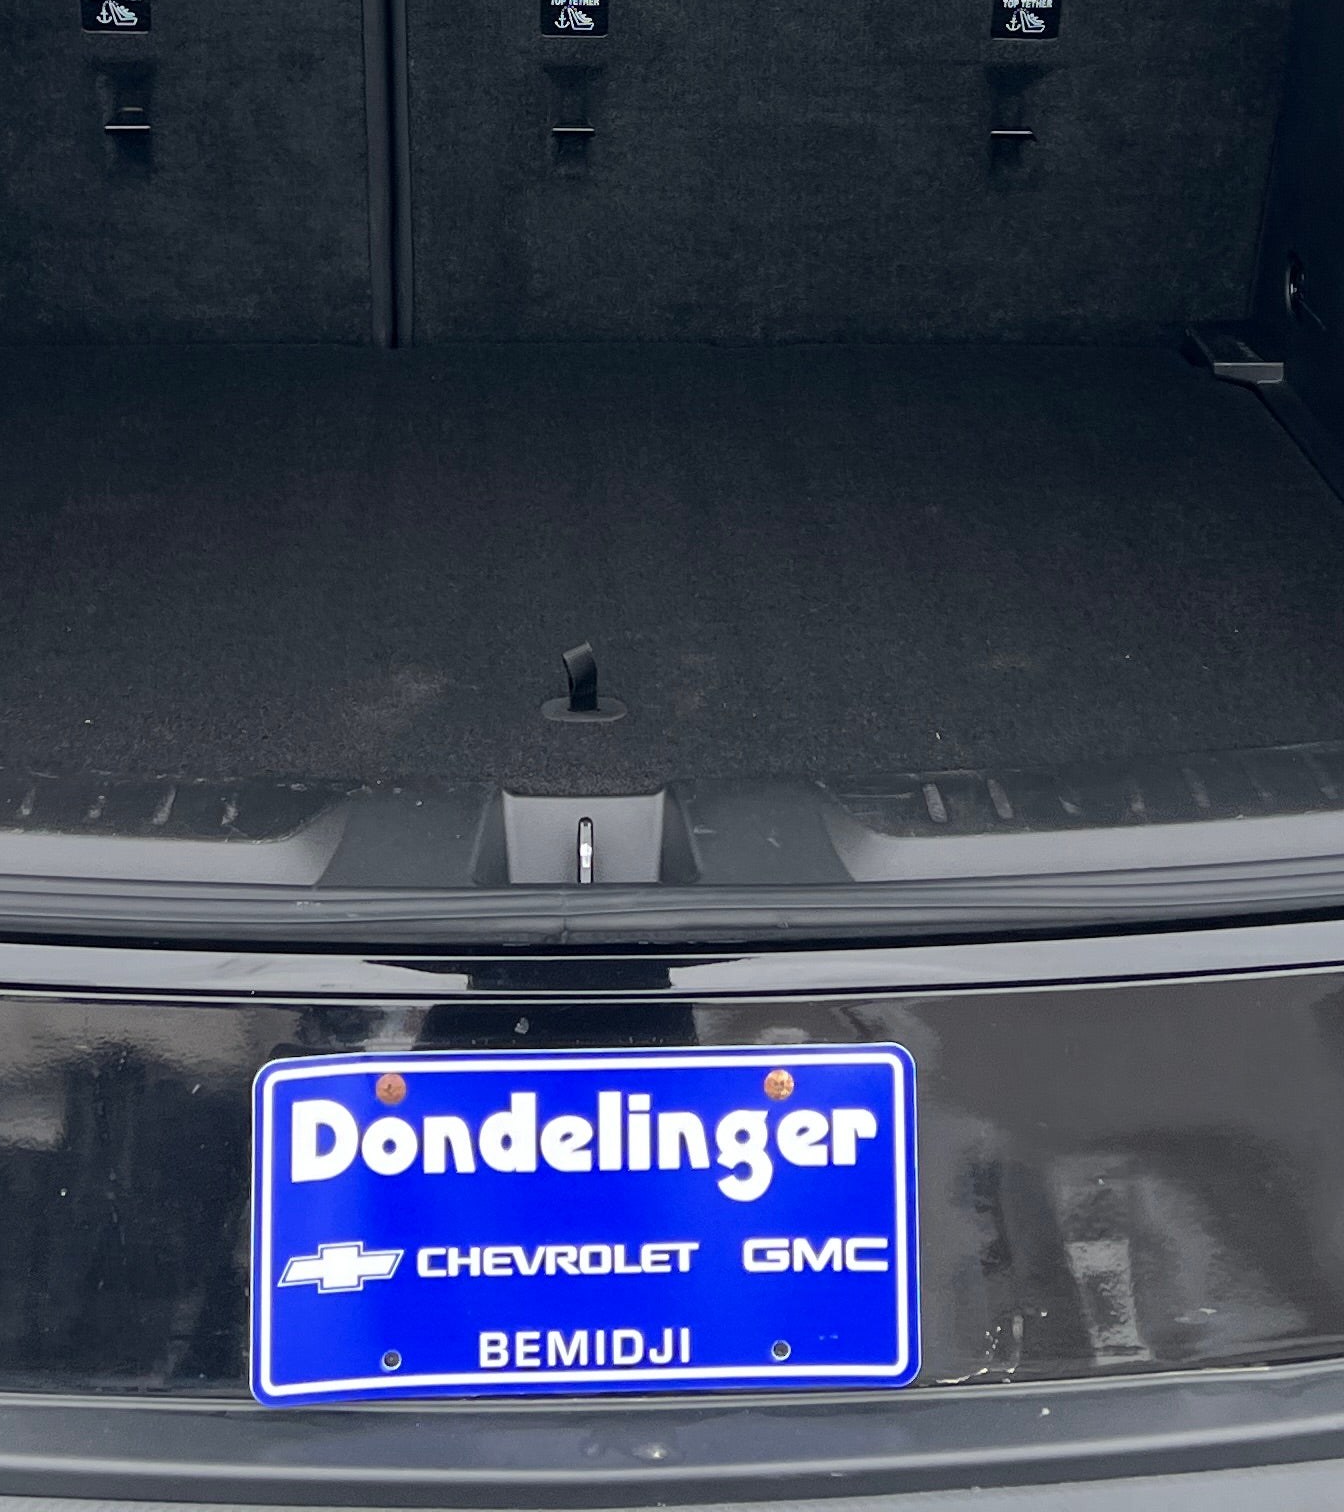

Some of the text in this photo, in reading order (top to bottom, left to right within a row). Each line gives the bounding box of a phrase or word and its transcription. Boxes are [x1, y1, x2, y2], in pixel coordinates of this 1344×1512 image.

[1003, 0, 1053, 8] TOP TETHER
[290, 1091, 878, 1203] Dondelinger
[416, 1236, 890, 1278] CHEVROLET GMC
[479, 1327, 693, 1370] BEMIDJI
